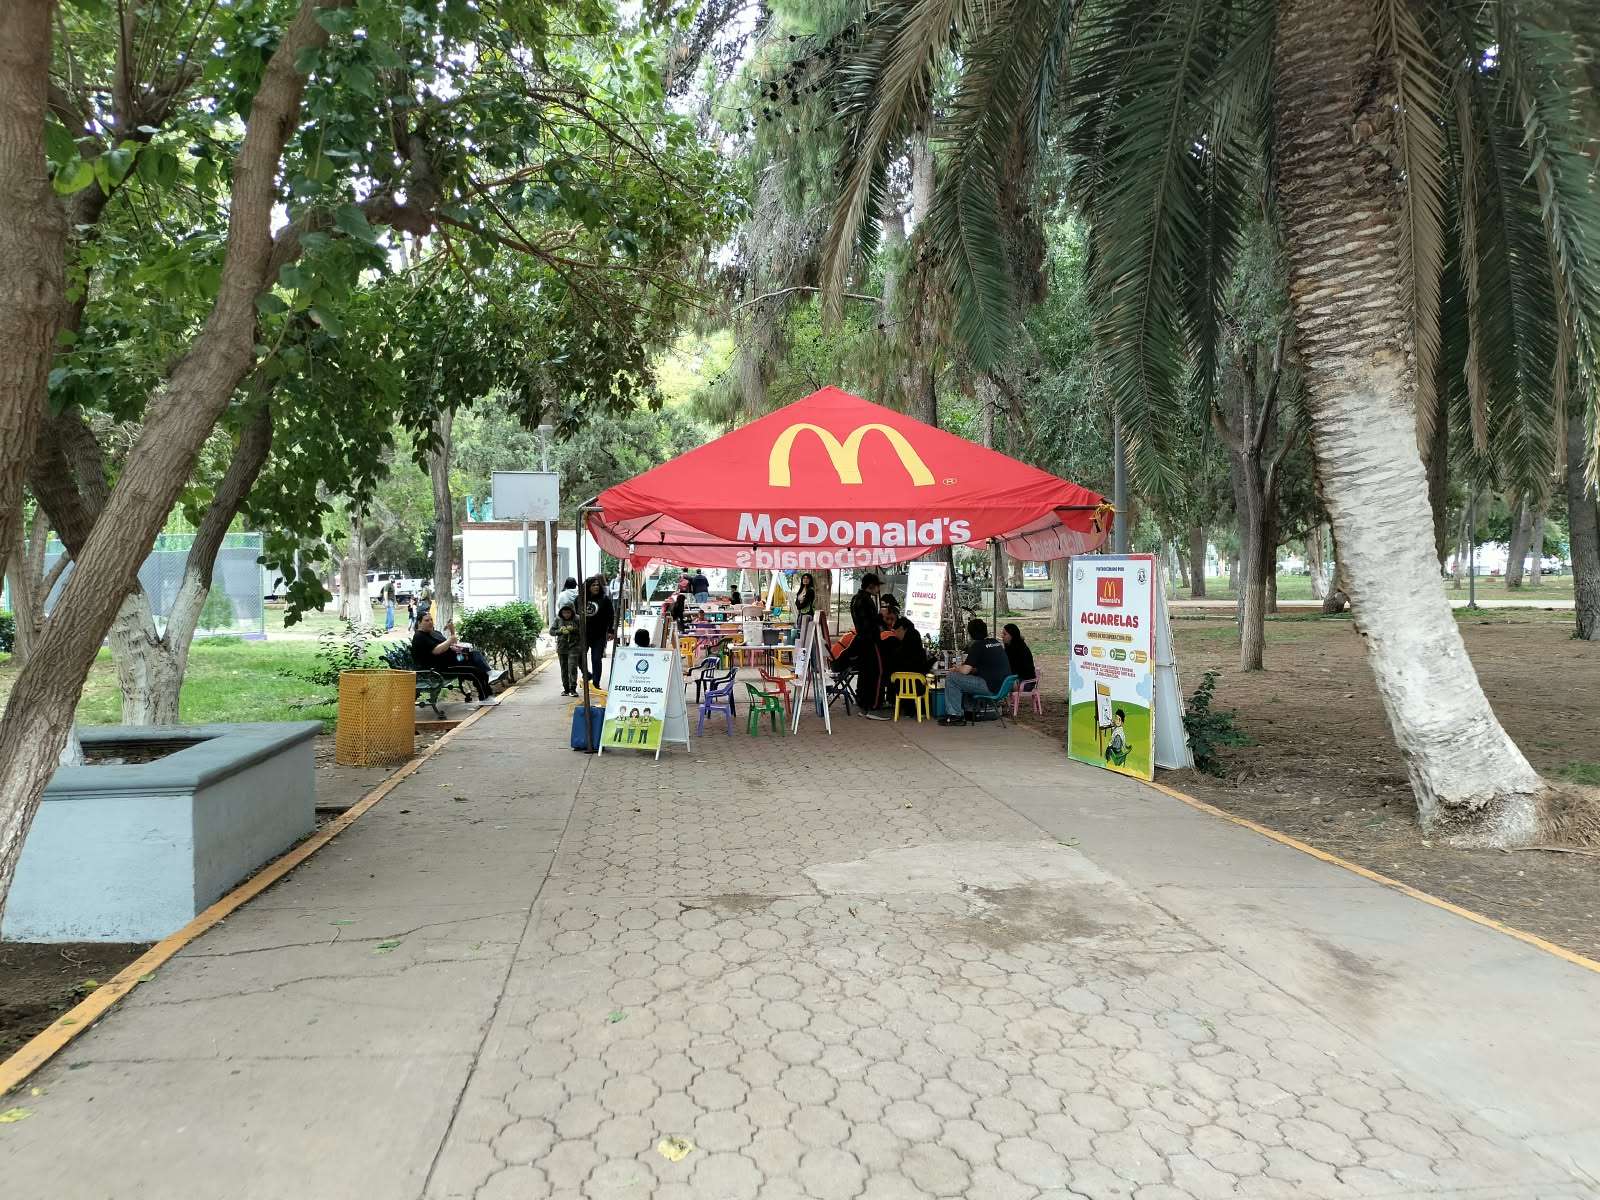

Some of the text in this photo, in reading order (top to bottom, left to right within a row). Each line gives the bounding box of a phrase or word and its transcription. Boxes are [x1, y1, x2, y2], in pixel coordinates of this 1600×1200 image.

[736, 512, 971, 547] McDonald's
[1081, 612, 1139, 628] ACUARELAS
[614, 685, 664, 694] SERVICIO SOCIAL
